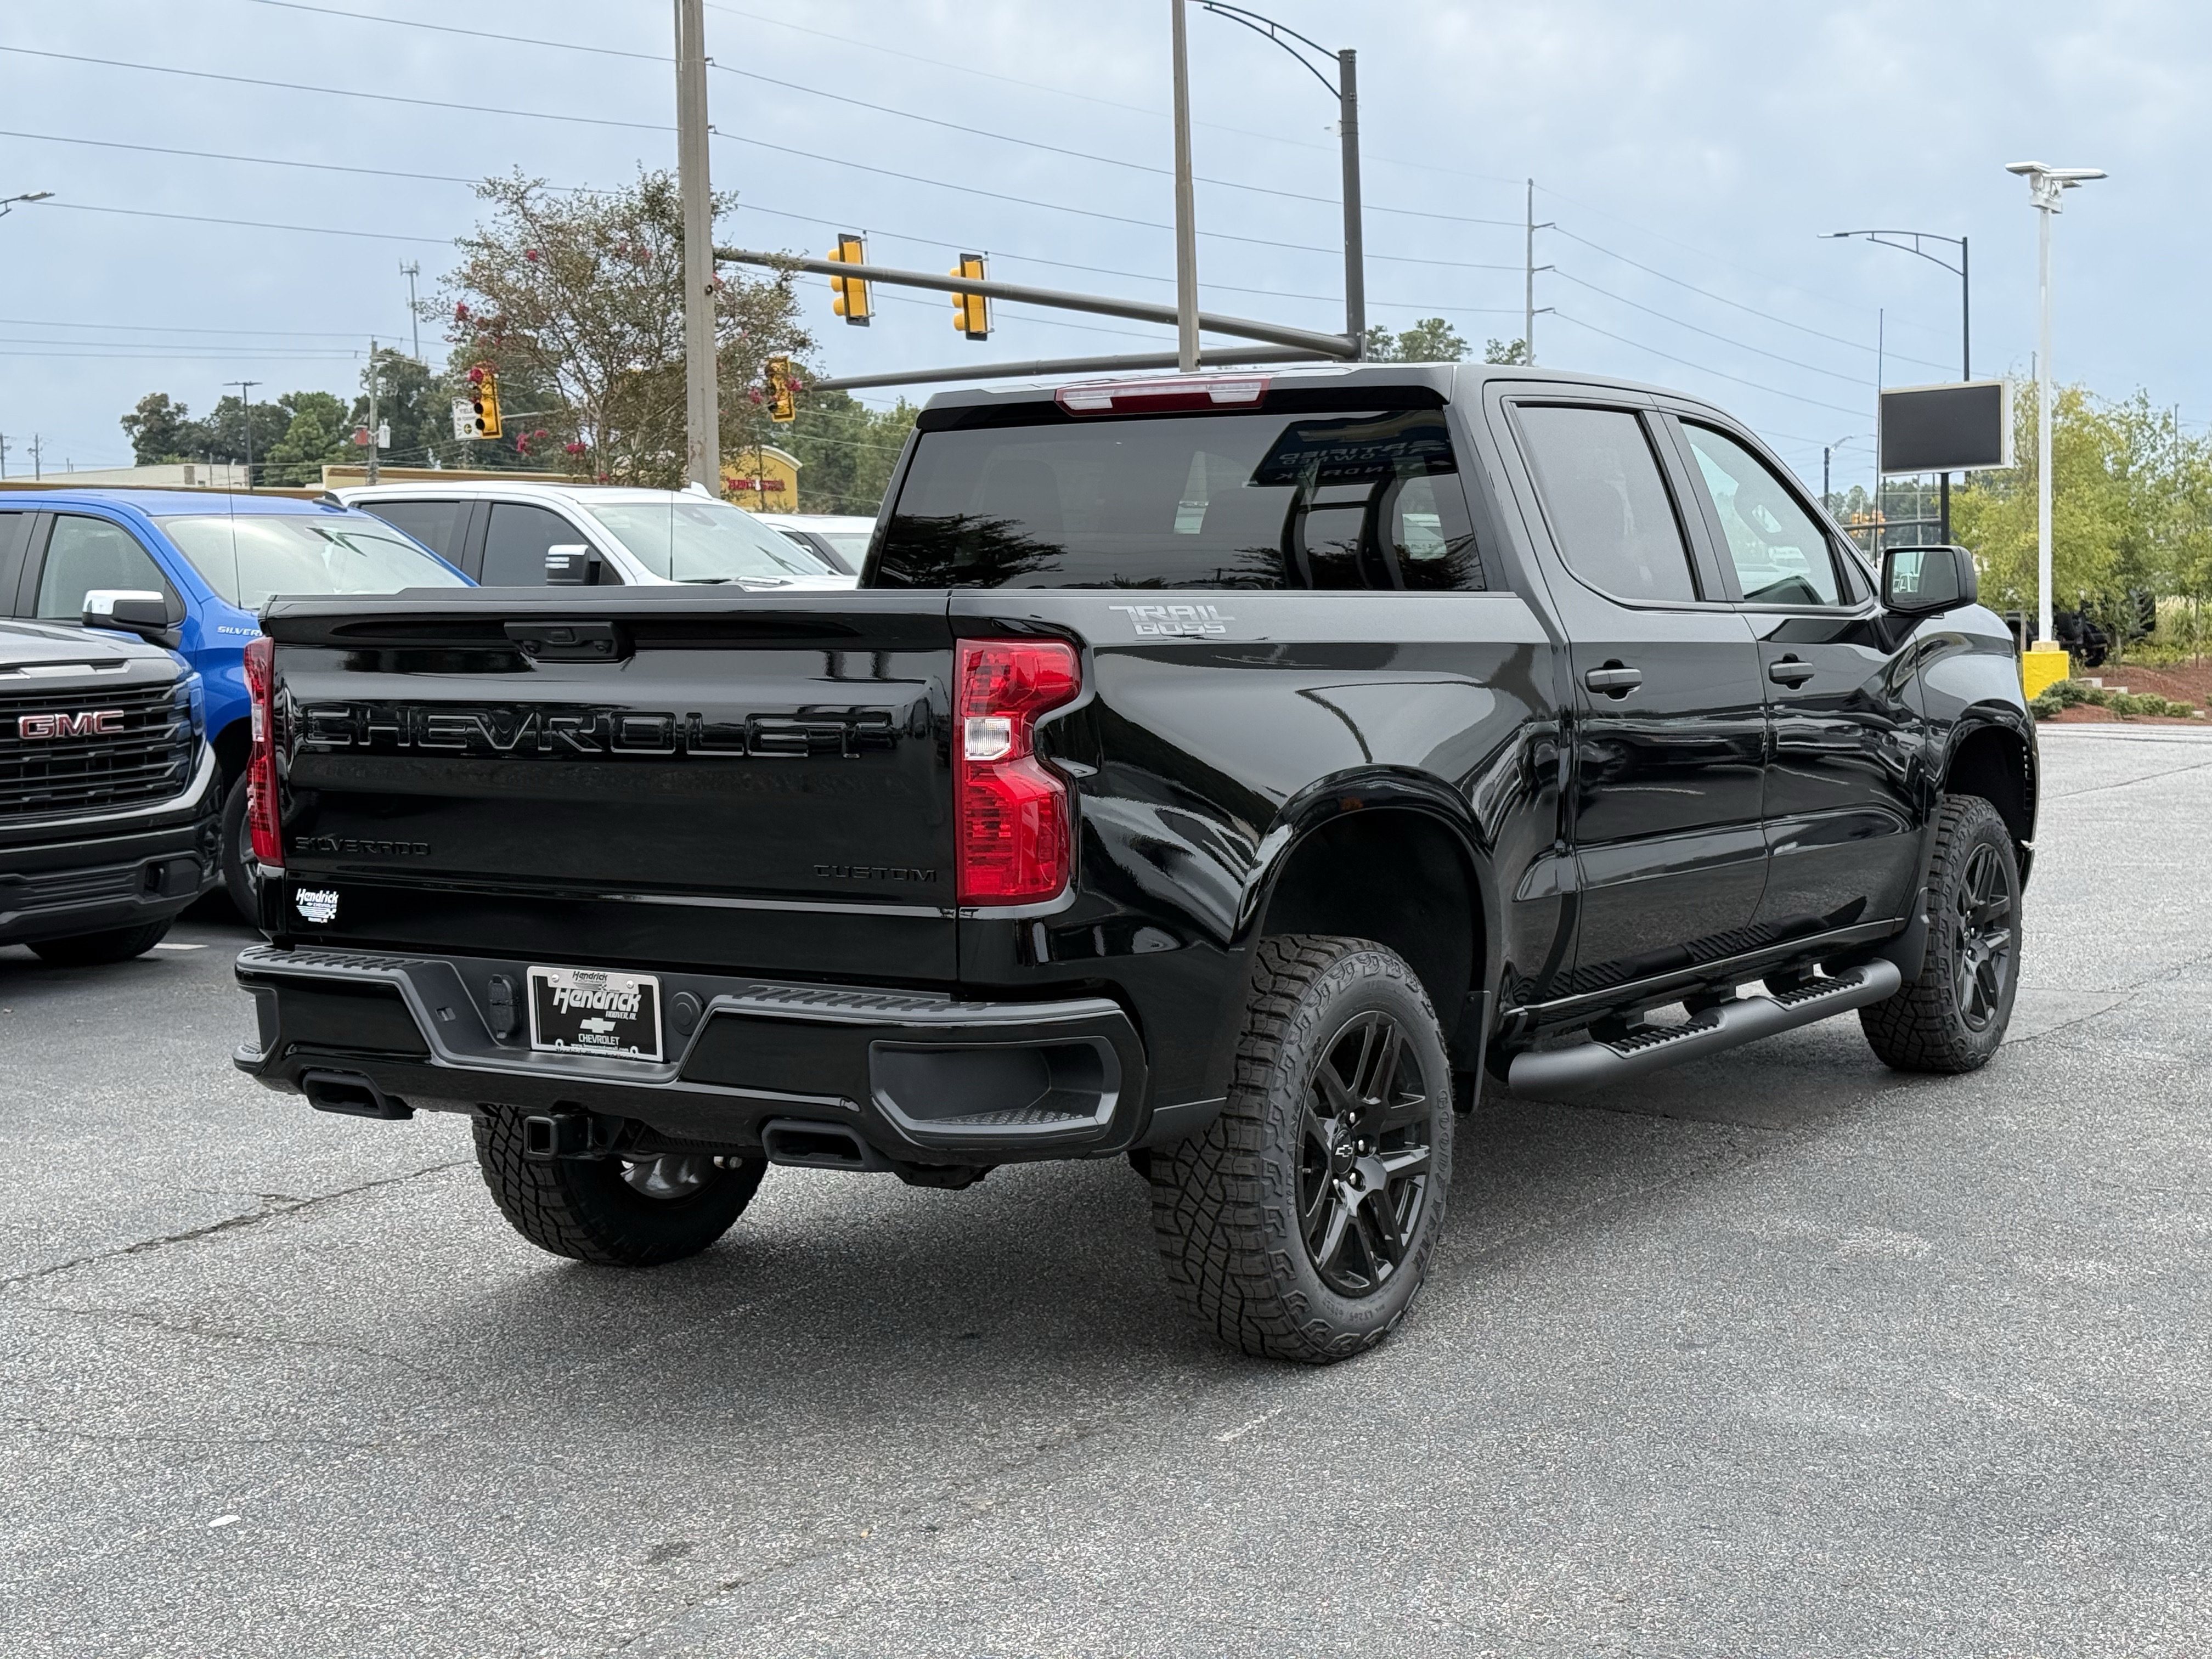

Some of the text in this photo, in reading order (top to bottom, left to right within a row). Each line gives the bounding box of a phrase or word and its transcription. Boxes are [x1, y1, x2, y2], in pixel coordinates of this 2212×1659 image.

[1108, 605, 1235, 622] TRAIL
[217, 626, 263, 636] SILVER
[1133, 621, 1227, 635] BOSS
[19, 710, 125, 740] GMC
[304, 707, 891, 759] CHEVROLET
[295, 837, 431, 856] SILVERADO
[814, 865, 937, 882] CUSTOM
[296, 888, 339, 905] Hendrick
[572, 970, 608, 981] Hendrick
[552, 987, 642, 1014] Hendrick
[578, 1033, 620, 1046] CHEVROLET
